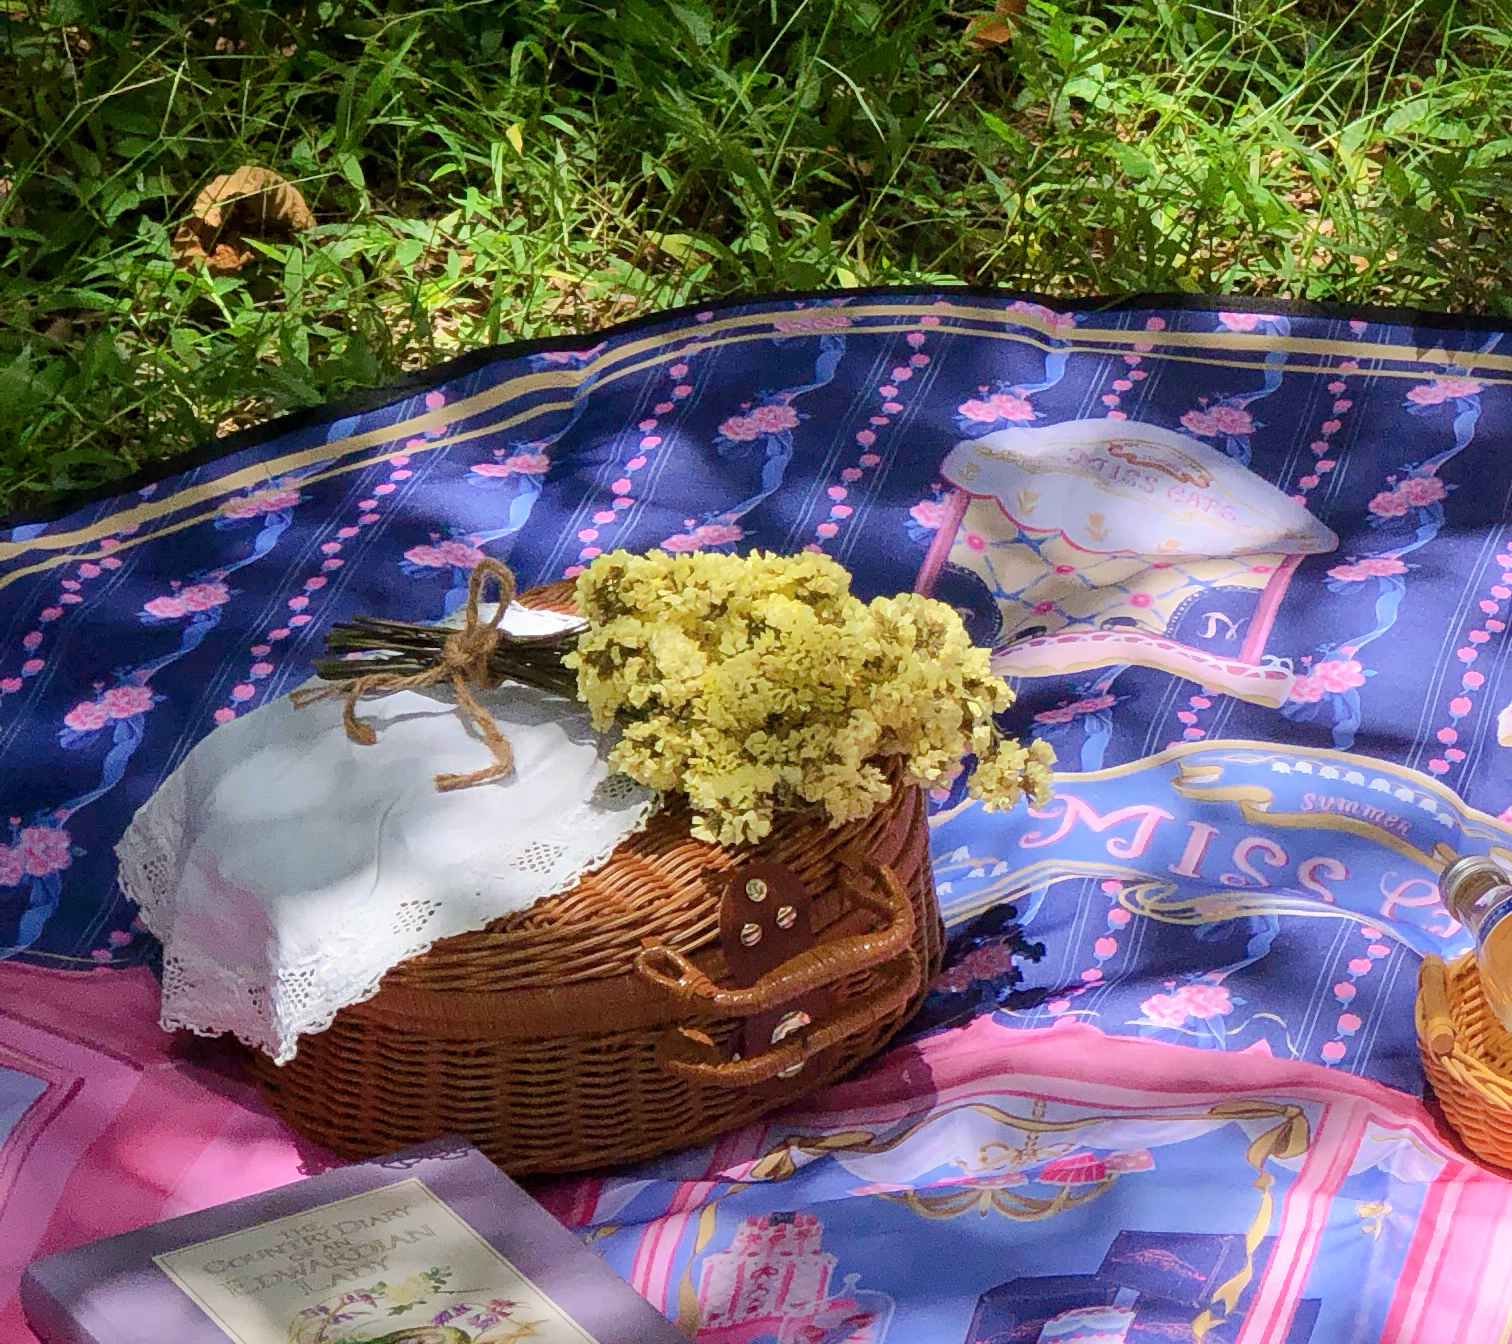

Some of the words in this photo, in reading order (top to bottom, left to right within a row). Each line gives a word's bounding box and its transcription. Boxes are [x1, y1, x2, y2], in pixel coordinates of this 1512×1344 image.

[1019, 793, 1350, 904] MISS
[276, 1221, 324, 1240] THE
[333, 1205, 413, 1236] DIARY
[296, 1254, 393, 1297] LADY
